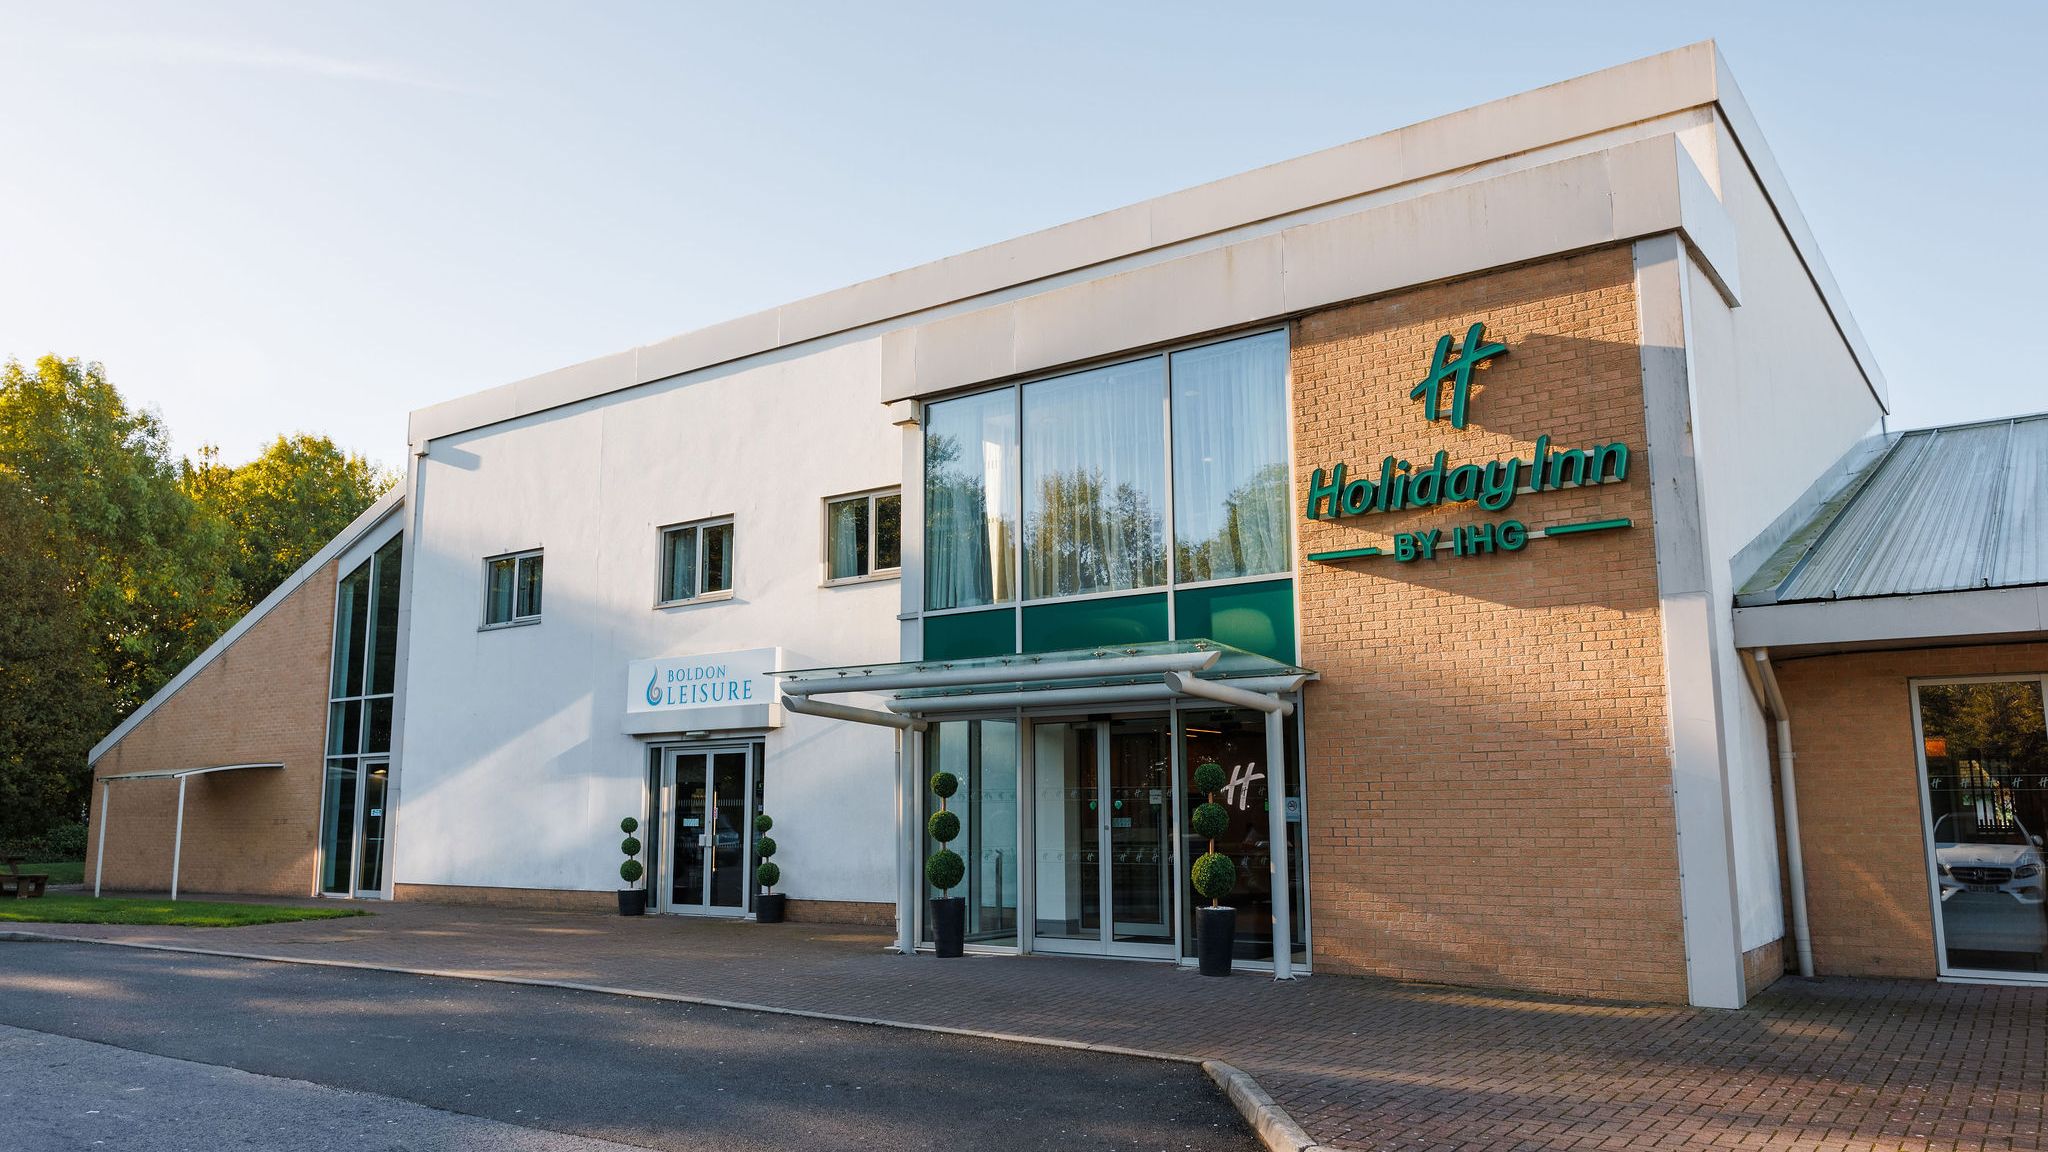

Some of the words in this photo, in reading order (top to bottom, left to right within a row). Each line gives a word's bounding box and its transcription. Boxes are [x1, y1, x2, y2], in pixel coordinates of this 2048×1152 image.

[1410, 322, 1509, 429] H
[1307, 450, 1521, 520] Holiday
[1531, 434, 1630, 492] Inn
[1394, 528, 1442, 563] BY
[1453, 520, 1529, 556] IHG
[667, 680, 753, 705] LEISURE
[668, 665, 727, 683] BOLDON
[1220, 762, 1266, 811] H
